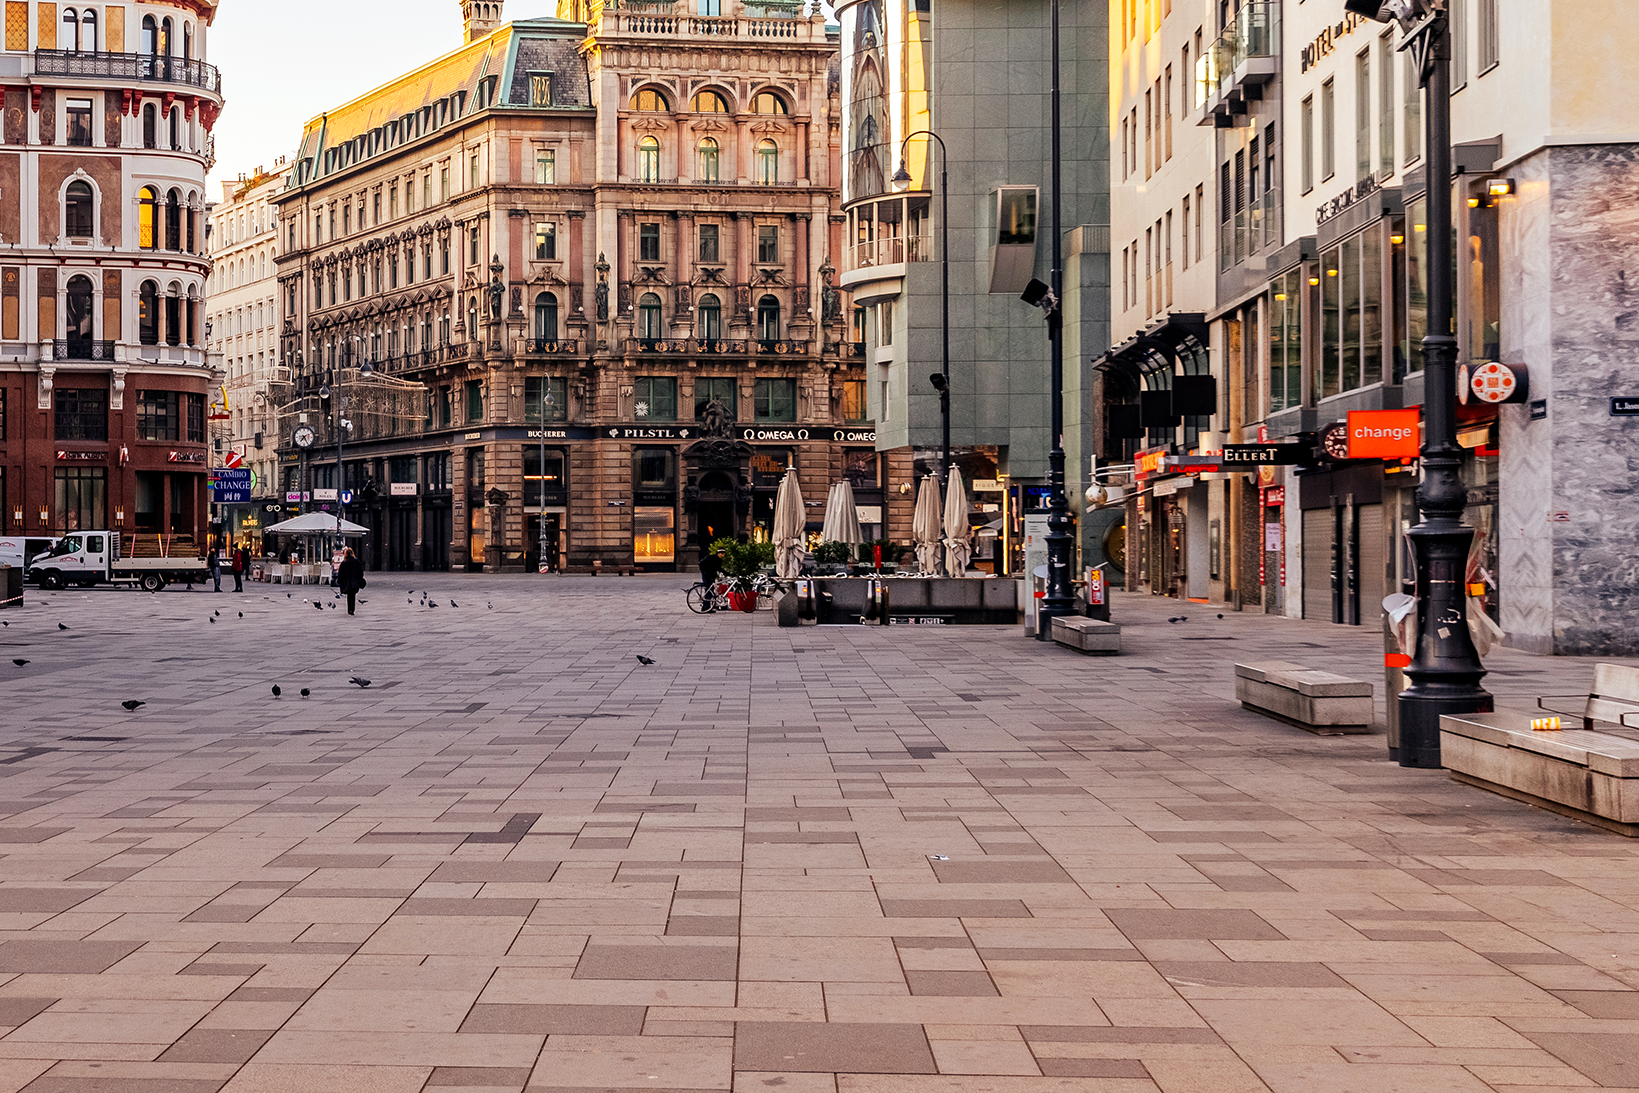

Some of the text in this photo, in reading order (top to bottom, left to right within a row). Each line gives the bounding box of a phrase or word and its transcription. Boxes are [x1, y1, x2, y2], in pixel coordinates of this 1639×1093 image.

[1300, 25, 1334, 75] HOTEL
[527, 430, 567, 438] BUCHERER
[624, 429, 675, 438] PILSTL
[757, 430, 795, 440] OMEGA
[847, 432, 876, 442] OMEG
[1354, 426, 1412, 441] change
[1224, 448, 1278, 461] ELLERT
[218, 470, 247, 478] CAMBIO
[214, 480, 251, 490] CHANGE
[342, 493, 352, 504] U
